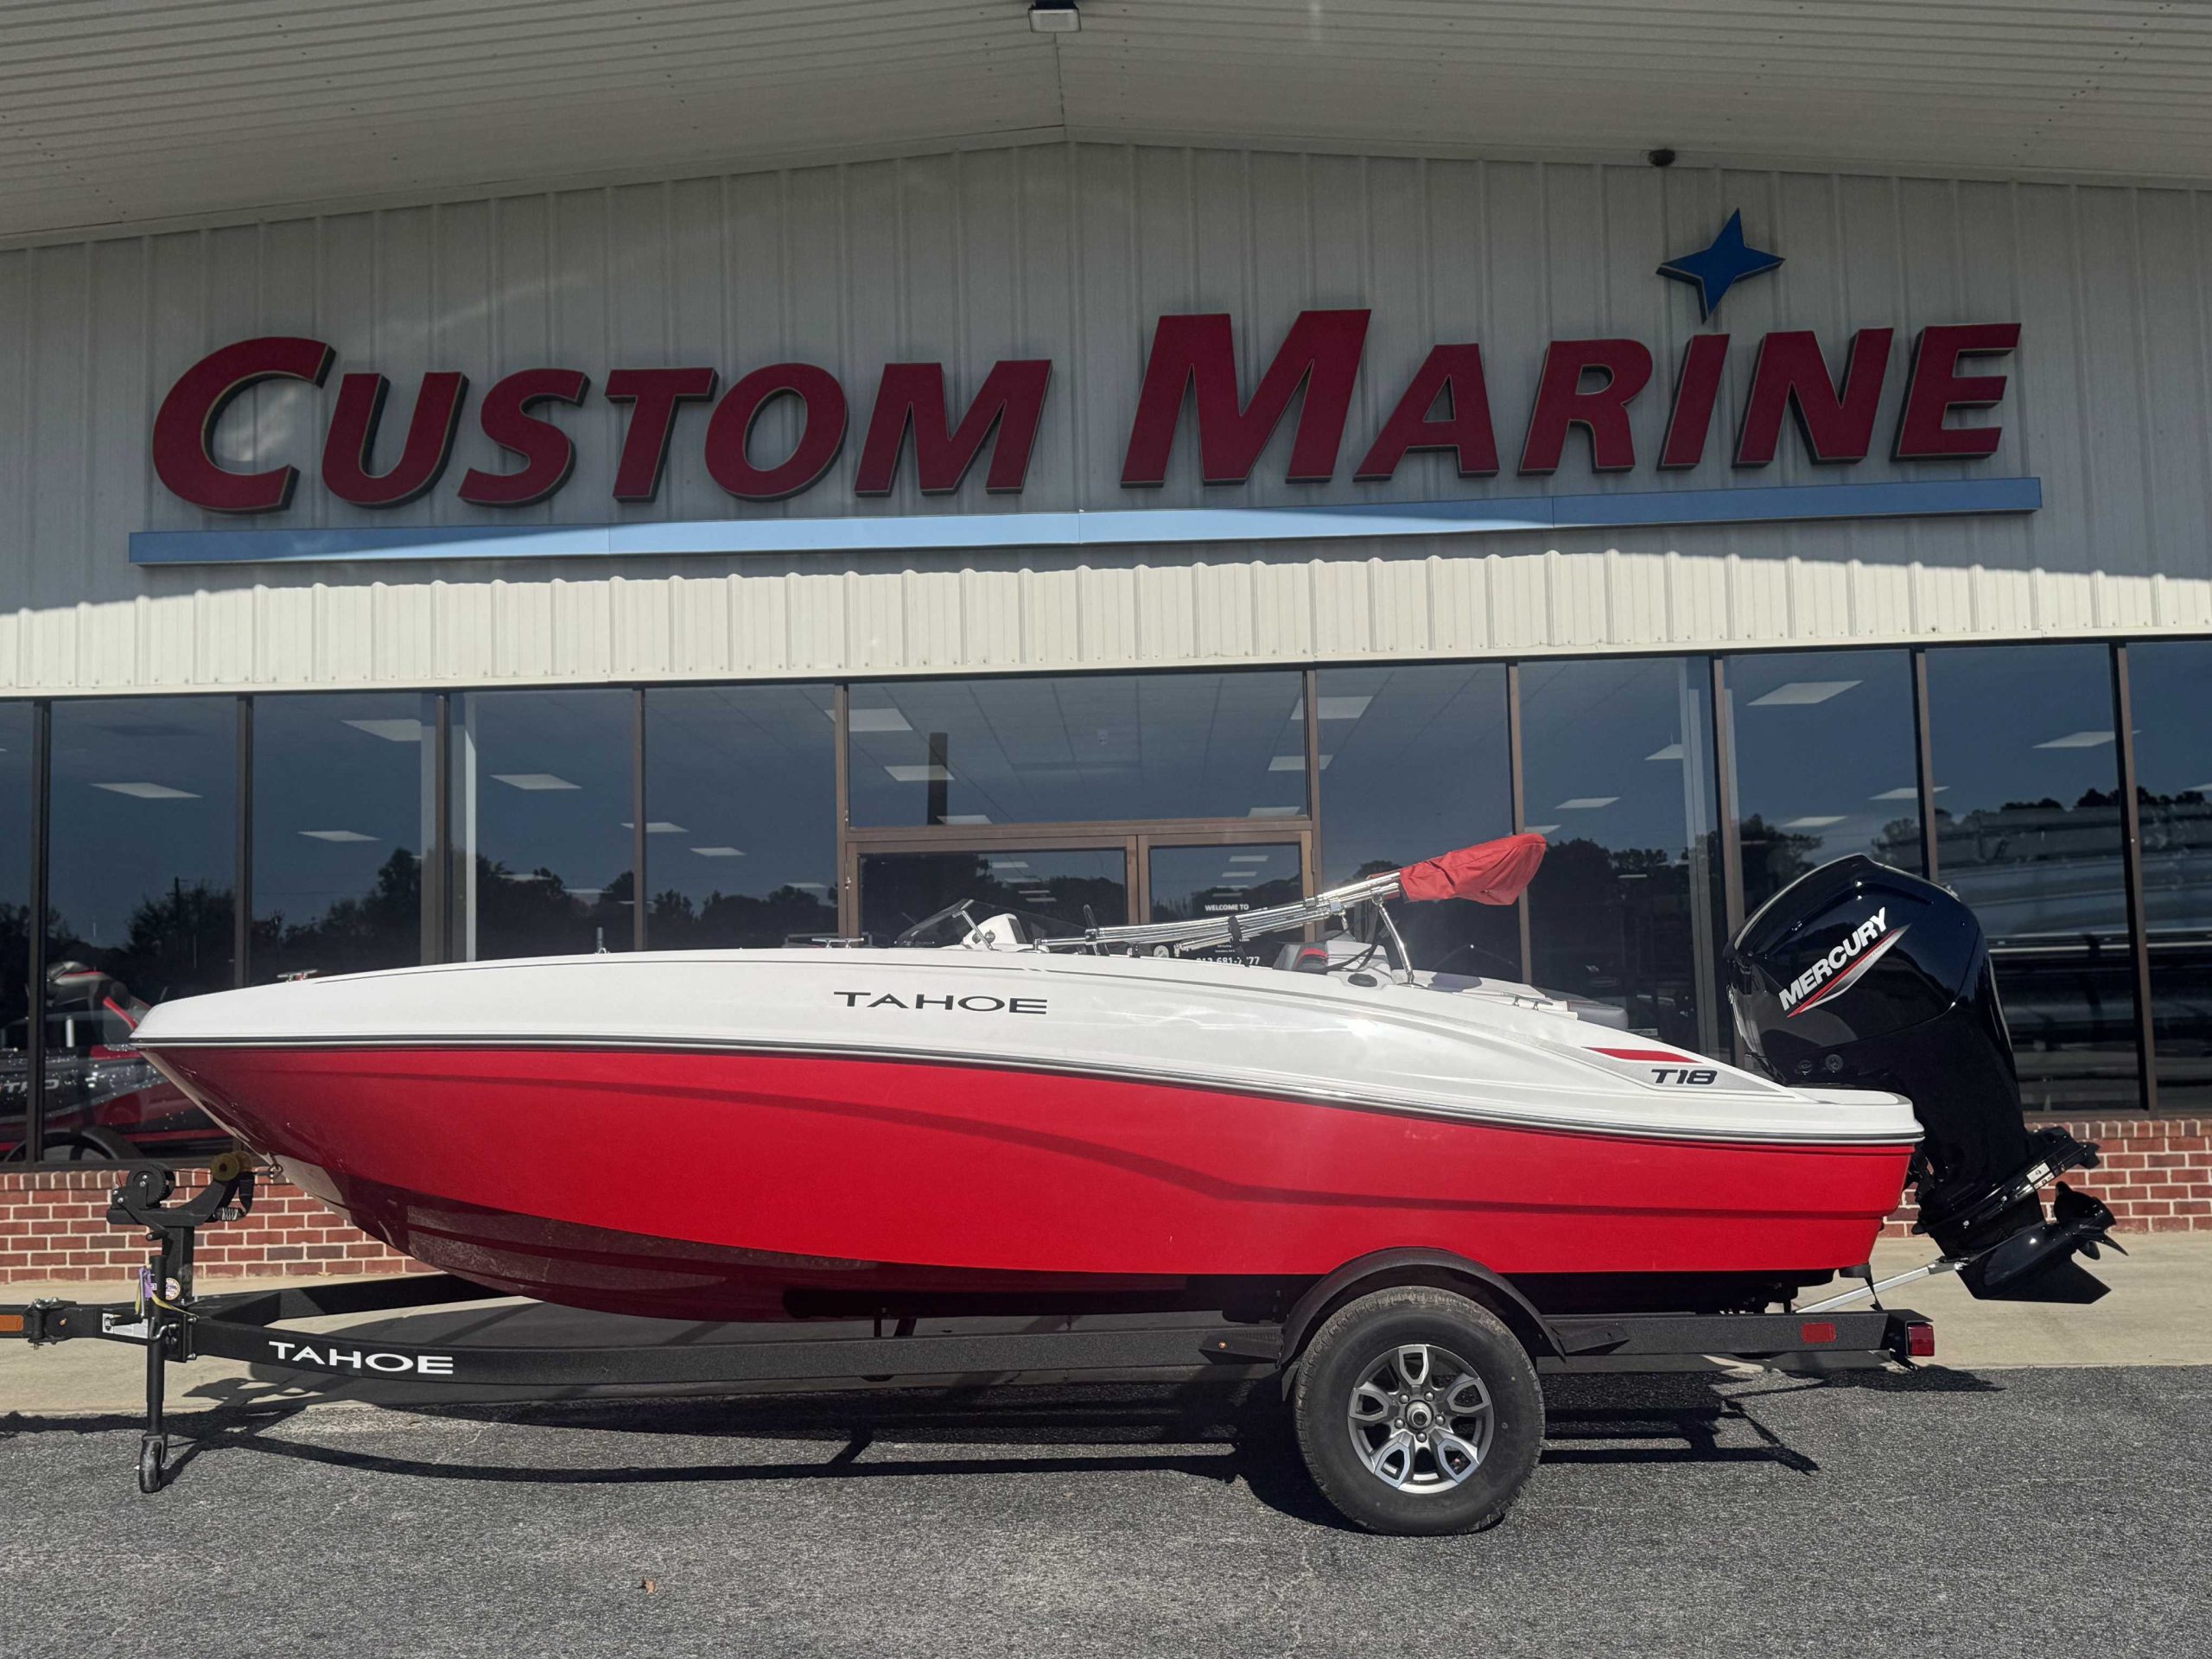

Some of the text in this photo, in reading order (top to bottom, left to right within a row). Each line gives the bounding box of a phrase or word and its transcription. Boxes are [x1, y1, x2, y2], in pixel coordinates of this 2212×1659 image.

[151, 308, 2022, 514] CUSTOM MARINE
[1778, 907, 1887, 1011] MERCURY
[833, 991, 1048, 1015] TAHOE
[1651, 1069, 1718, 1085] T18
[268, 1340, 454, 1375] TAHOE
